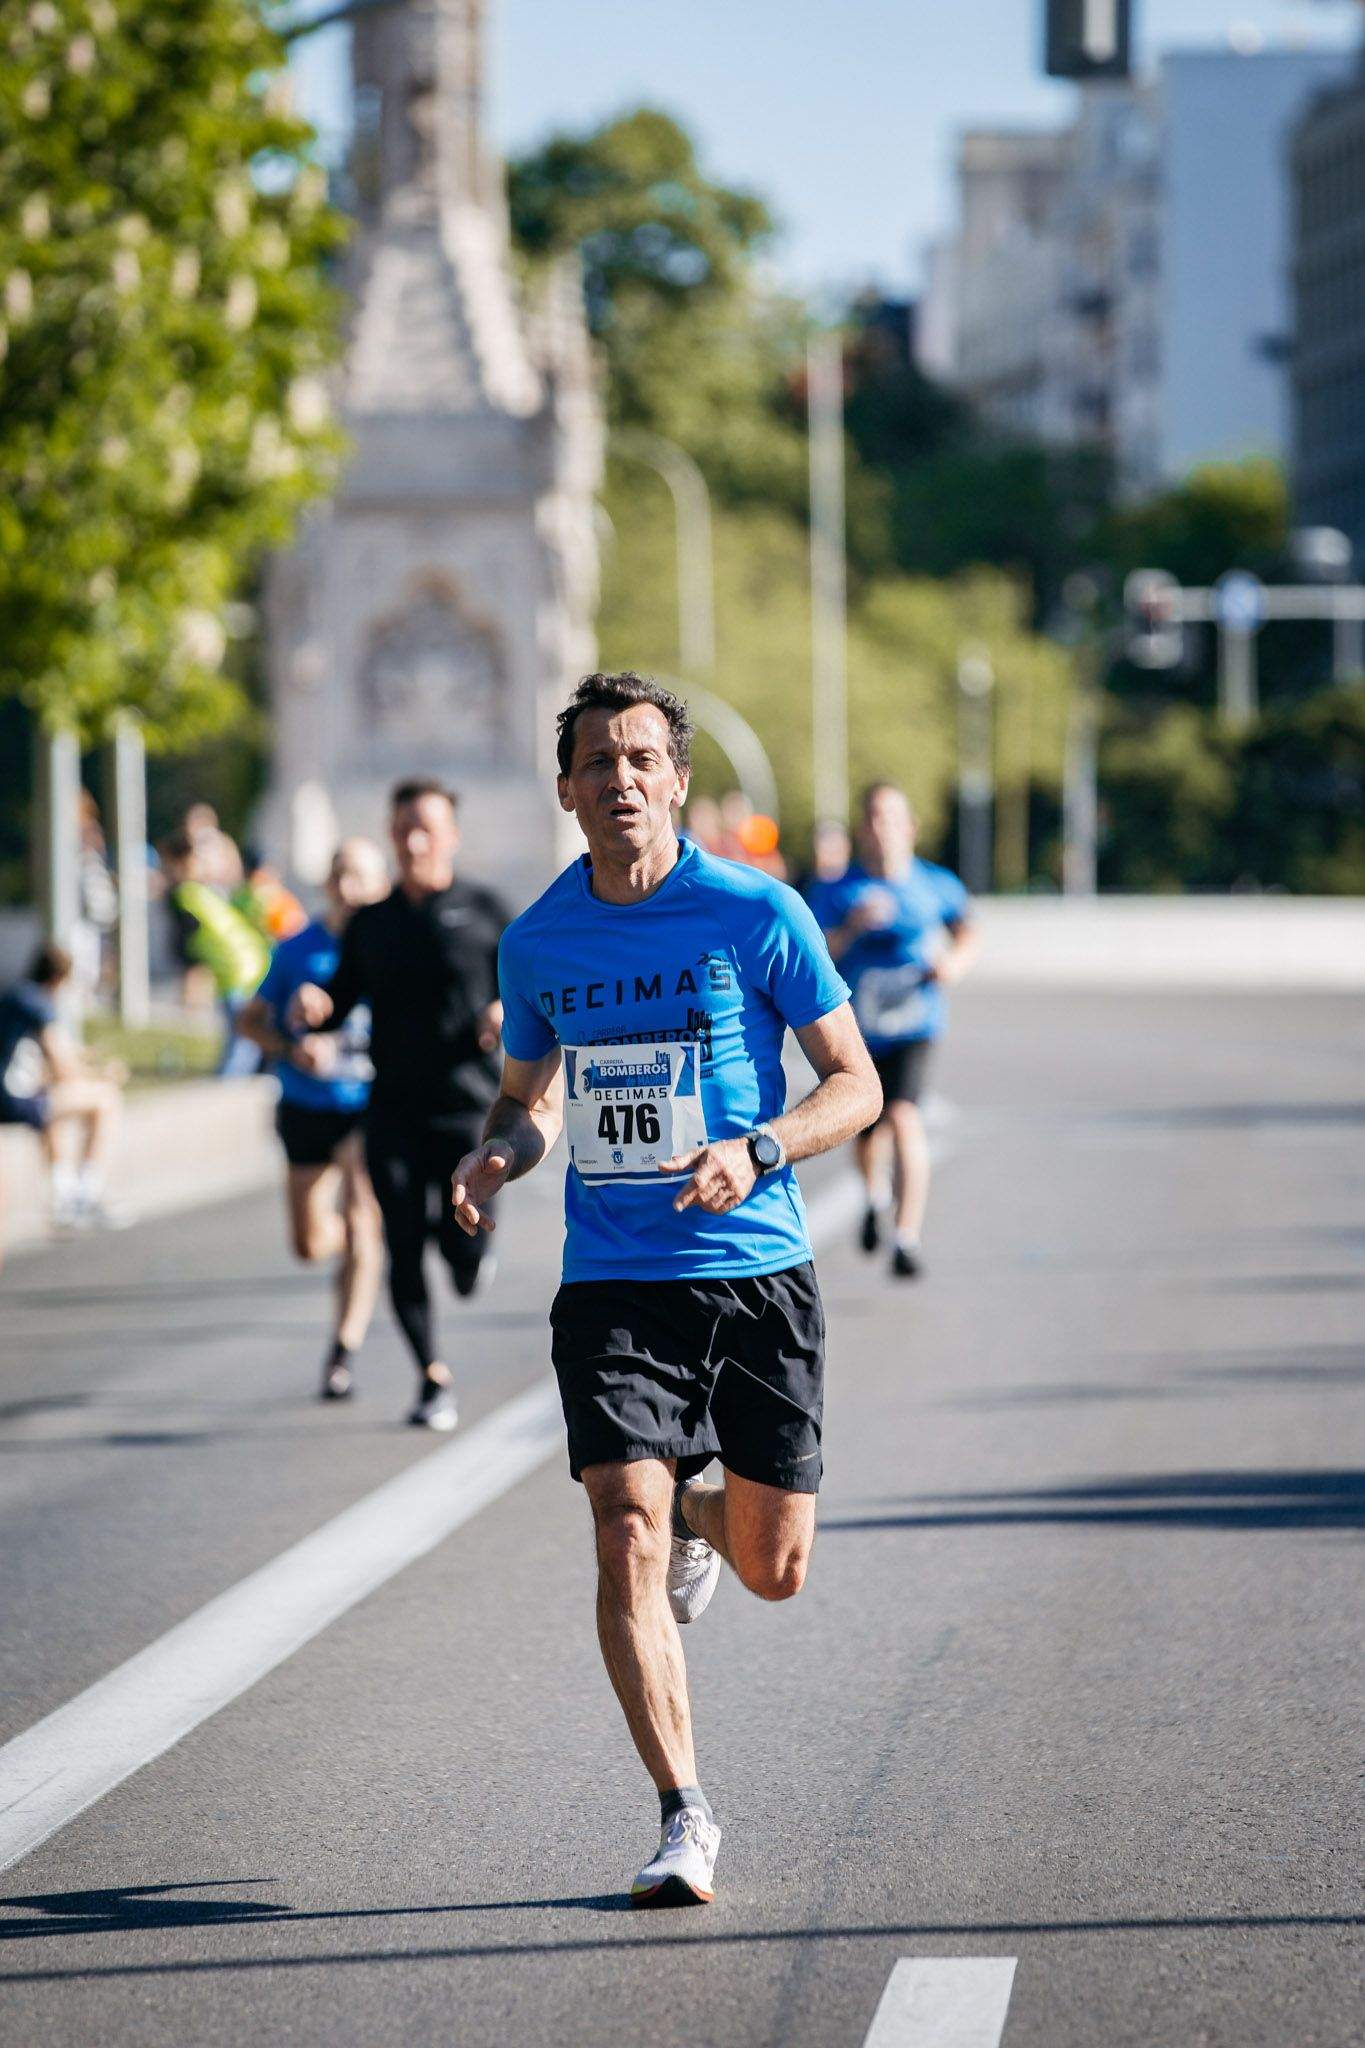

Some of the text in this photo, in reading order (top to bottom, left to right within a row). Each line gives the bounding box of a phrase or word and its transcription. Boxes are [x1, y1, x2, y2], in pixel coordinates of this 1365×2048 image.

[540, 964, 731, 1017] DECIMAS
[600, 1063, 668, 1077] BOMBEROS
[594, 1087, 667, 1101] DECIMAS
[597, 1102, 661, 1145] 476
